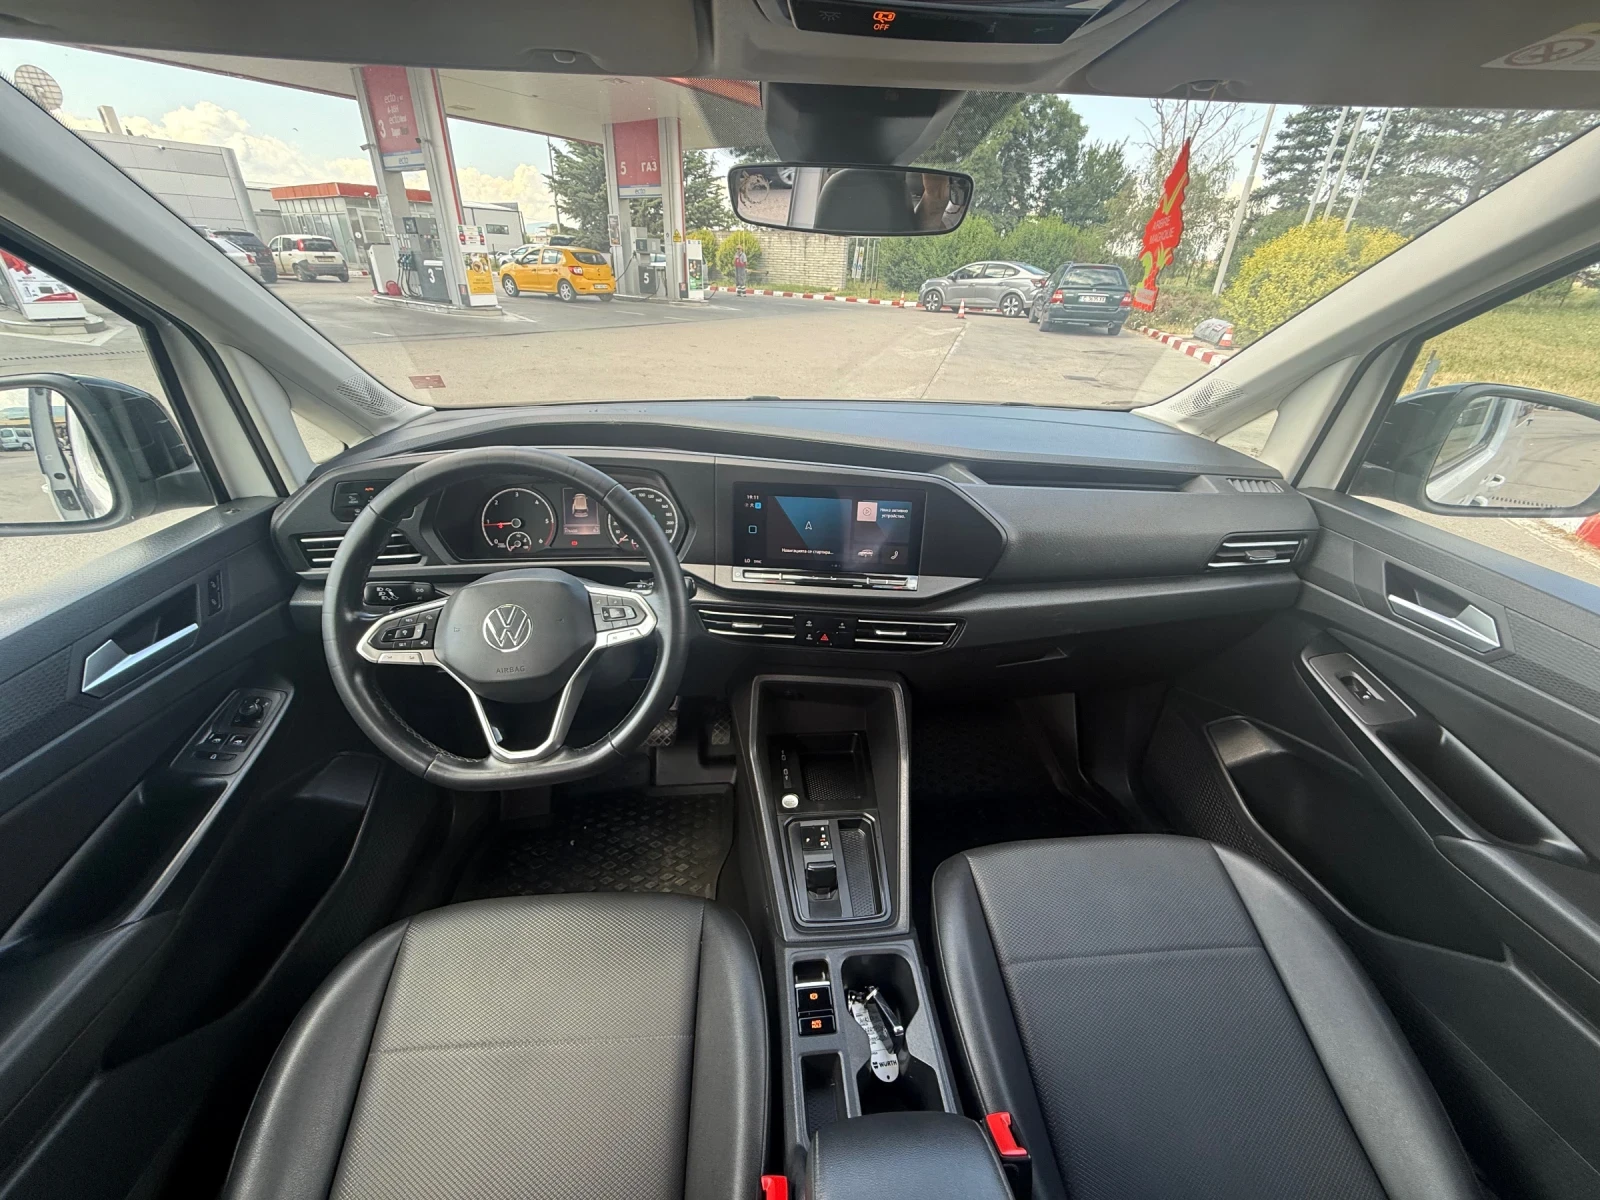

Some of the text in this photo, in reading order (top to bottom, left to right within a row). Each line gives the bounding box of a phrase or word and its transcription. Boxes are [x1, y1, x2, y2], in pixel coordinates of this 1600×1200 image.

[873, 23, 890, 31] OFF
[378, 119, 387, 139] 3
[620, 161, 627, 175] 5
[641, 161, 658, 172] ГАЗ
[427, 268, 436, 284] 3
[643, 272, 650, 284] 5
[496, 665, 526, 674] AIRBAG
